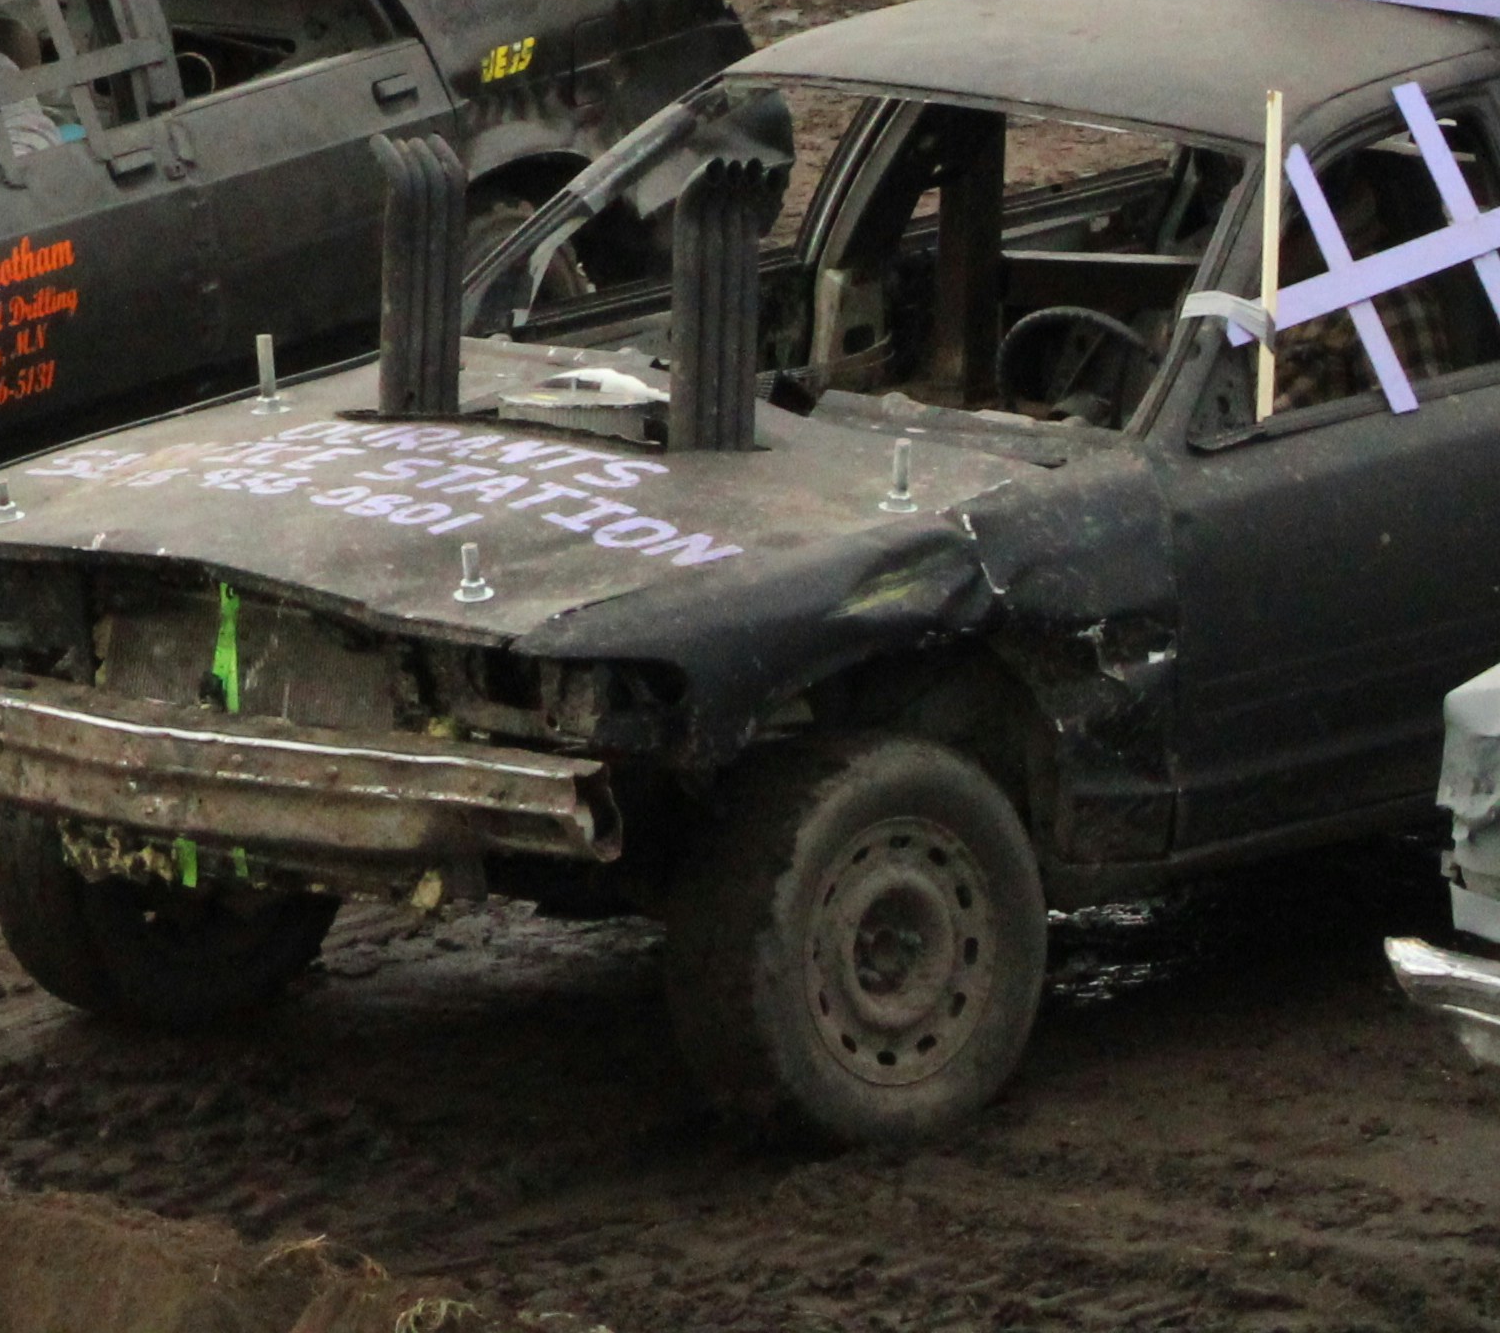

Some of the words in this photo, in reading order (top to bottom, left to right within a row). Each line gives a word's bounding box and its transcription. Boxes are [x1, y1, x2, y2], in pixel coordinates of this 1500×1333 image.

[7, 285, 80, 326] Drilling
[264, 421, 670, 489] DURANTS
[355, 457, 745, 566] STATION
